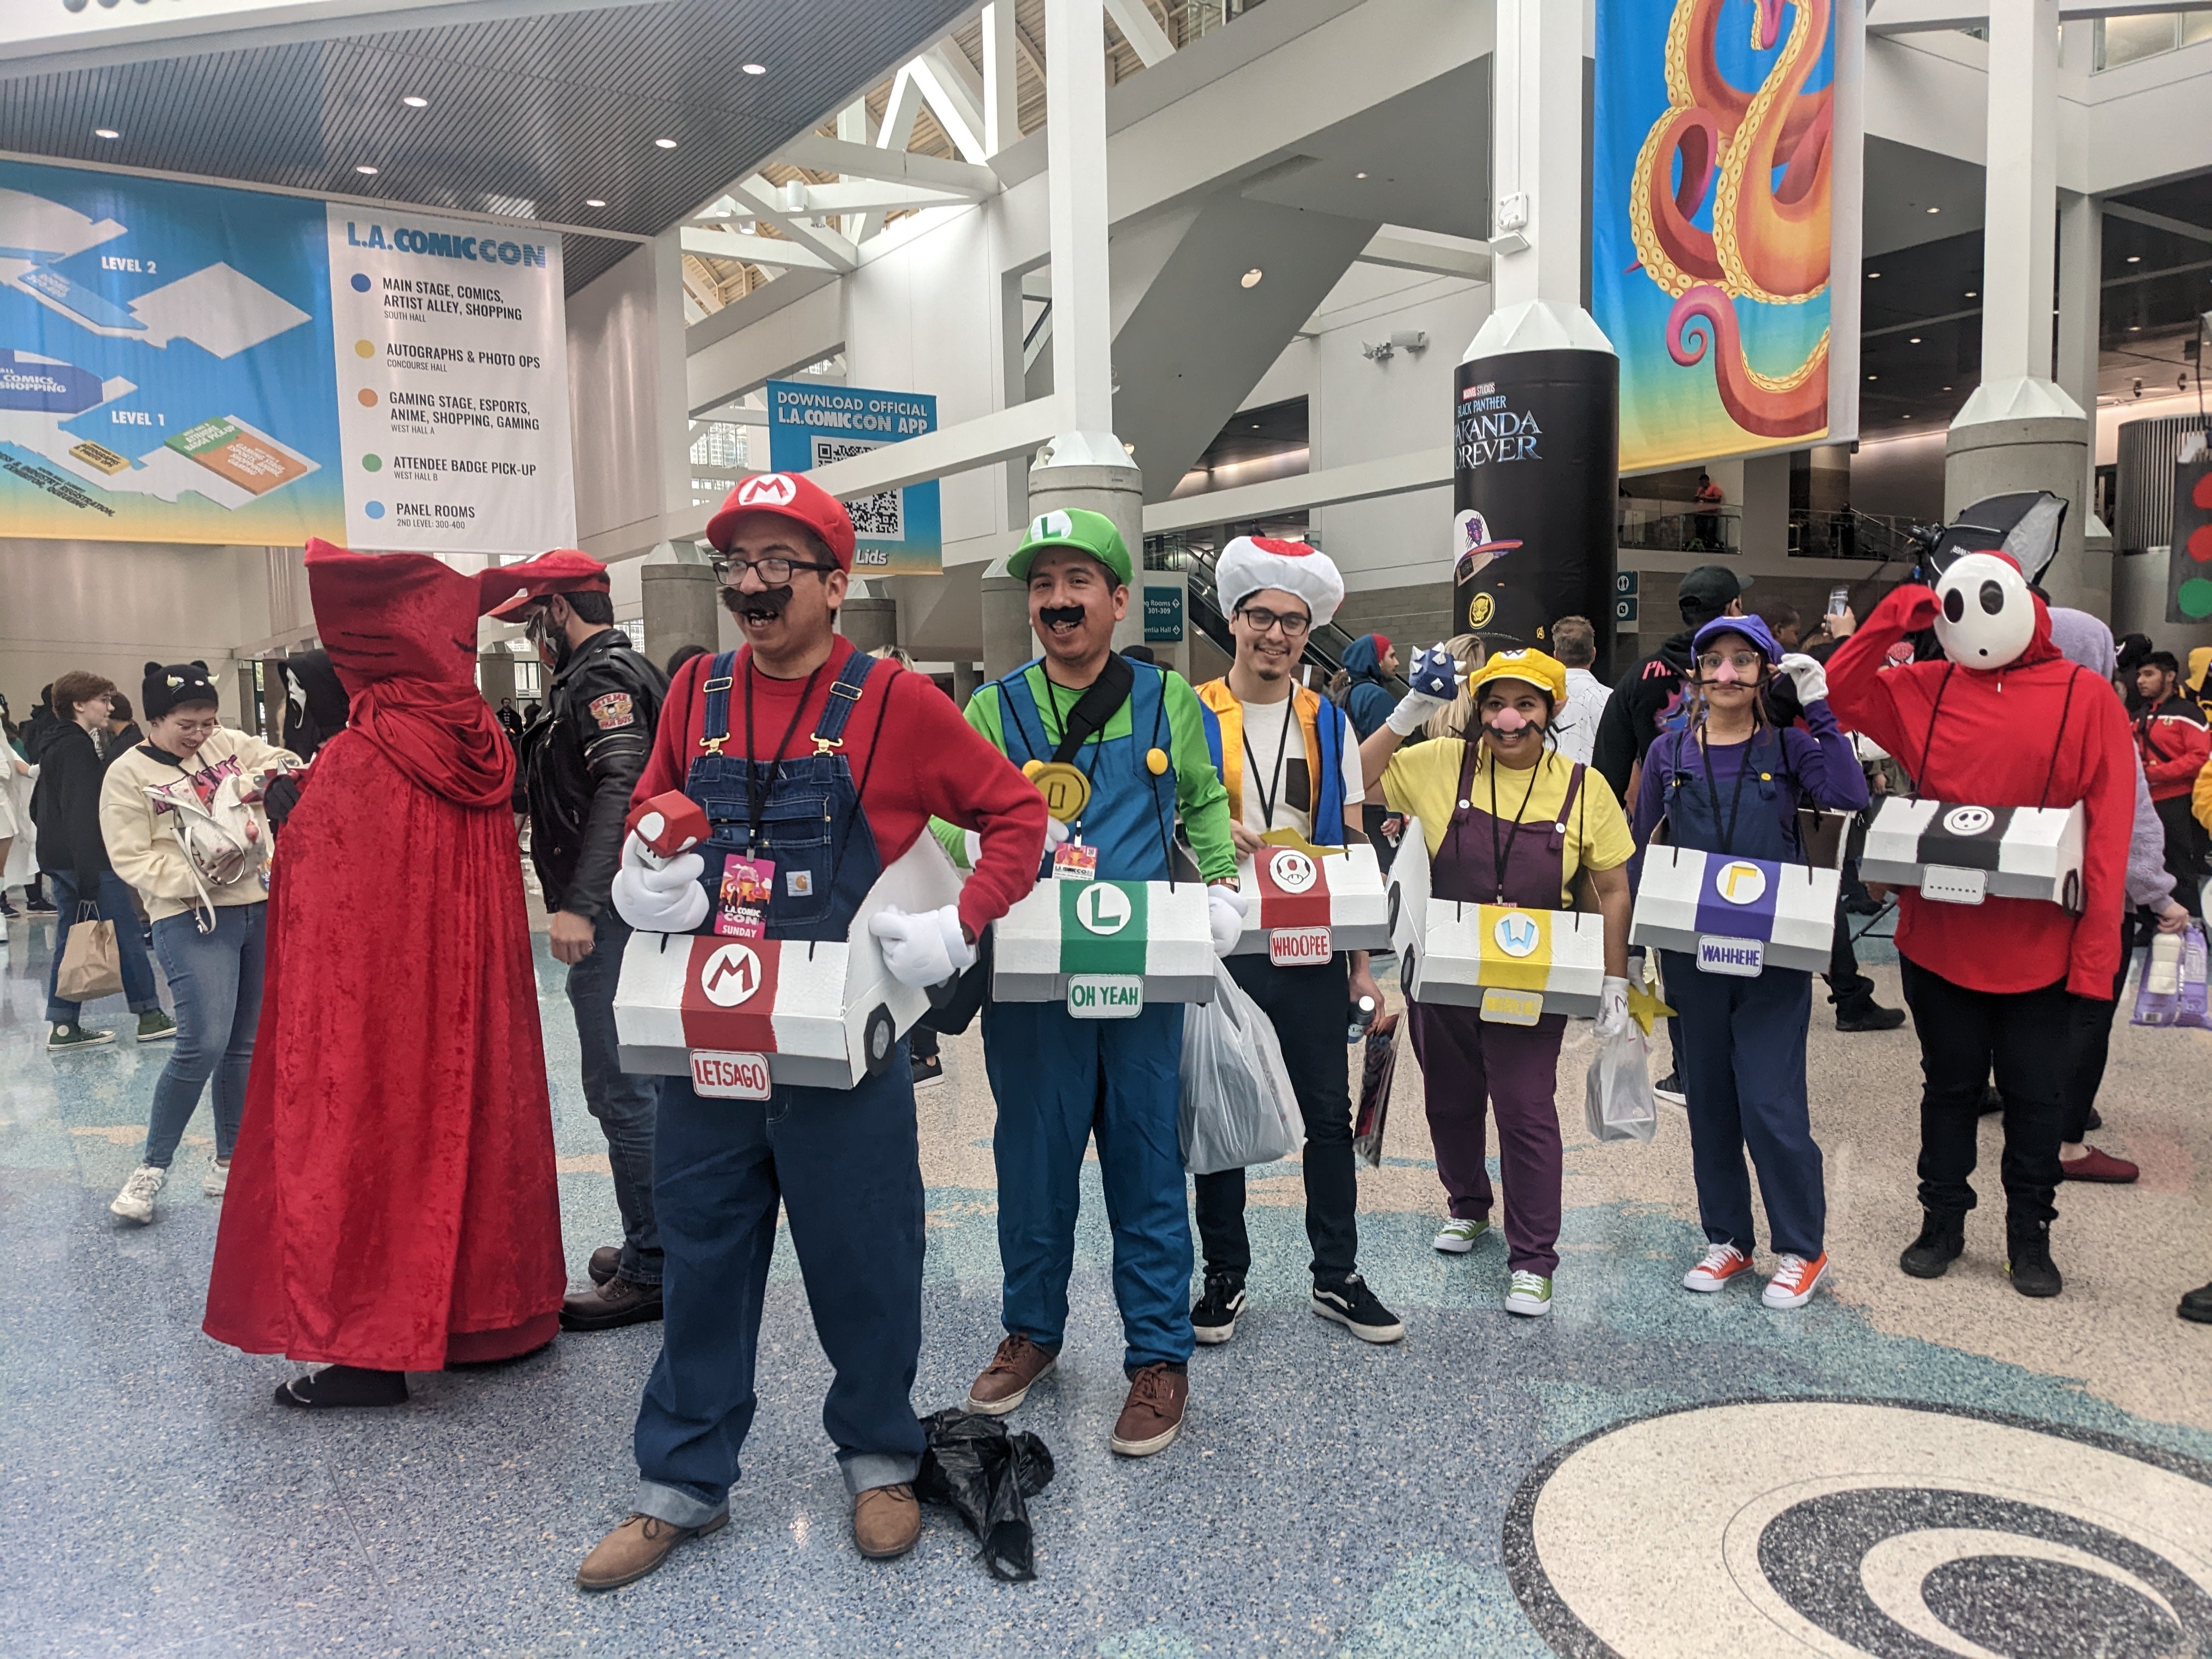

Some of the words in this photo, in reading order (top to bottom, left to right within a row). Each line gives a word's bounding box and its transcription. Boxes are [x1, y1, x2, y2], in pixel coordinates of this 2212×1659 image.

[101, 256, 142, 272] LEVEL
[147, 261, 156, 274] 2
[383, 277, 412, 292] MAIN
[416, 280, 454, 298] STAGE,
[457, 285, 504, 303] COMICS,
[384, 295, 423, 311] ARTIST
[427, 299, 462, 315] ALLEY,
[466, 303, 522, 320] SHOPPING
[384, 311, 408, 320] SOUTH
[409, 313, 426, 323] HALL
[387, 343, 463, 362] AUTOGRAPHS
[467, 351, 475, 363] &
[479, 352, 515, 366] PHOTO
[519, 356, 540, 369] OPS
[387, 359, 429, 370] CONCOURSE
[431, 363, 448, 373] HALL
[1463, 387, 1476, 400] MARVEL
[1477, 383, 1495, 396] STUDIOS
[390, 391, 435, 407] GAMING
[439, 395, 476, 411] STAGE,
[479, 398, 530, 415] ESPORTS,
[777, 391, 864, 410] DOWNLOAD
[869, 400, 928, 417] OFFICIAL
[1458, 402, 1471, 418] BLACK
[1474, 396, 1506, 413] PANTHER
[112, 410, 152, 425] LEVEL
[157, 413, 165, 426] 1
[391, 408, 429, 424] ANIME,
[433, 411, 493, 428] SHOPPING,
[496, 416, 539, 431] GAMING
[898, 417, 928, 435] APP
[1454, 410, 1543, 446] AKANDA
[391, 424, 410, 433] WEST
[411, 425, 428, 435] HALL
[1455, 436, 1543, 470] OREVER
[394, 456, 448, 471] ATTENDEE
[452, 460, 488, 473] BADGE
[492, 462, 536, 476] PICK-UP
[394, 471, 413, 480] WEST
[414, 472, 431, 481] HALL
[433, 473, 438, 481] B
[744, 480, 788, 501] M
[397, 503, 431, 517] PANEL
[435, 505, 475, 518] ROOMS
[397, 518, 411, 527] 2ND
[413, 520, 434, 528] LEVEL:
[436, 521, 465, 529] 300-400
[1041, 516, 1062, 539] L
[856, 549, 888, 565] Lids
[1091, 888, 1121, 927] L
[724, 912, 758, 926] CON
[722, 924, 757, 938] SUNDAY
[1501, 919, 1535, 950] W
[1272, 935, 1328, 957] WHOOPEE
[1702, 944, 1760, 967] WAHHEHE
[708, 953, 754, 994] M
[1071, 984, 1096, 1007] OH
[1099, 985, 1138, 1006] YEAH
[694, 1059, 766, 1091] LETSAGO
